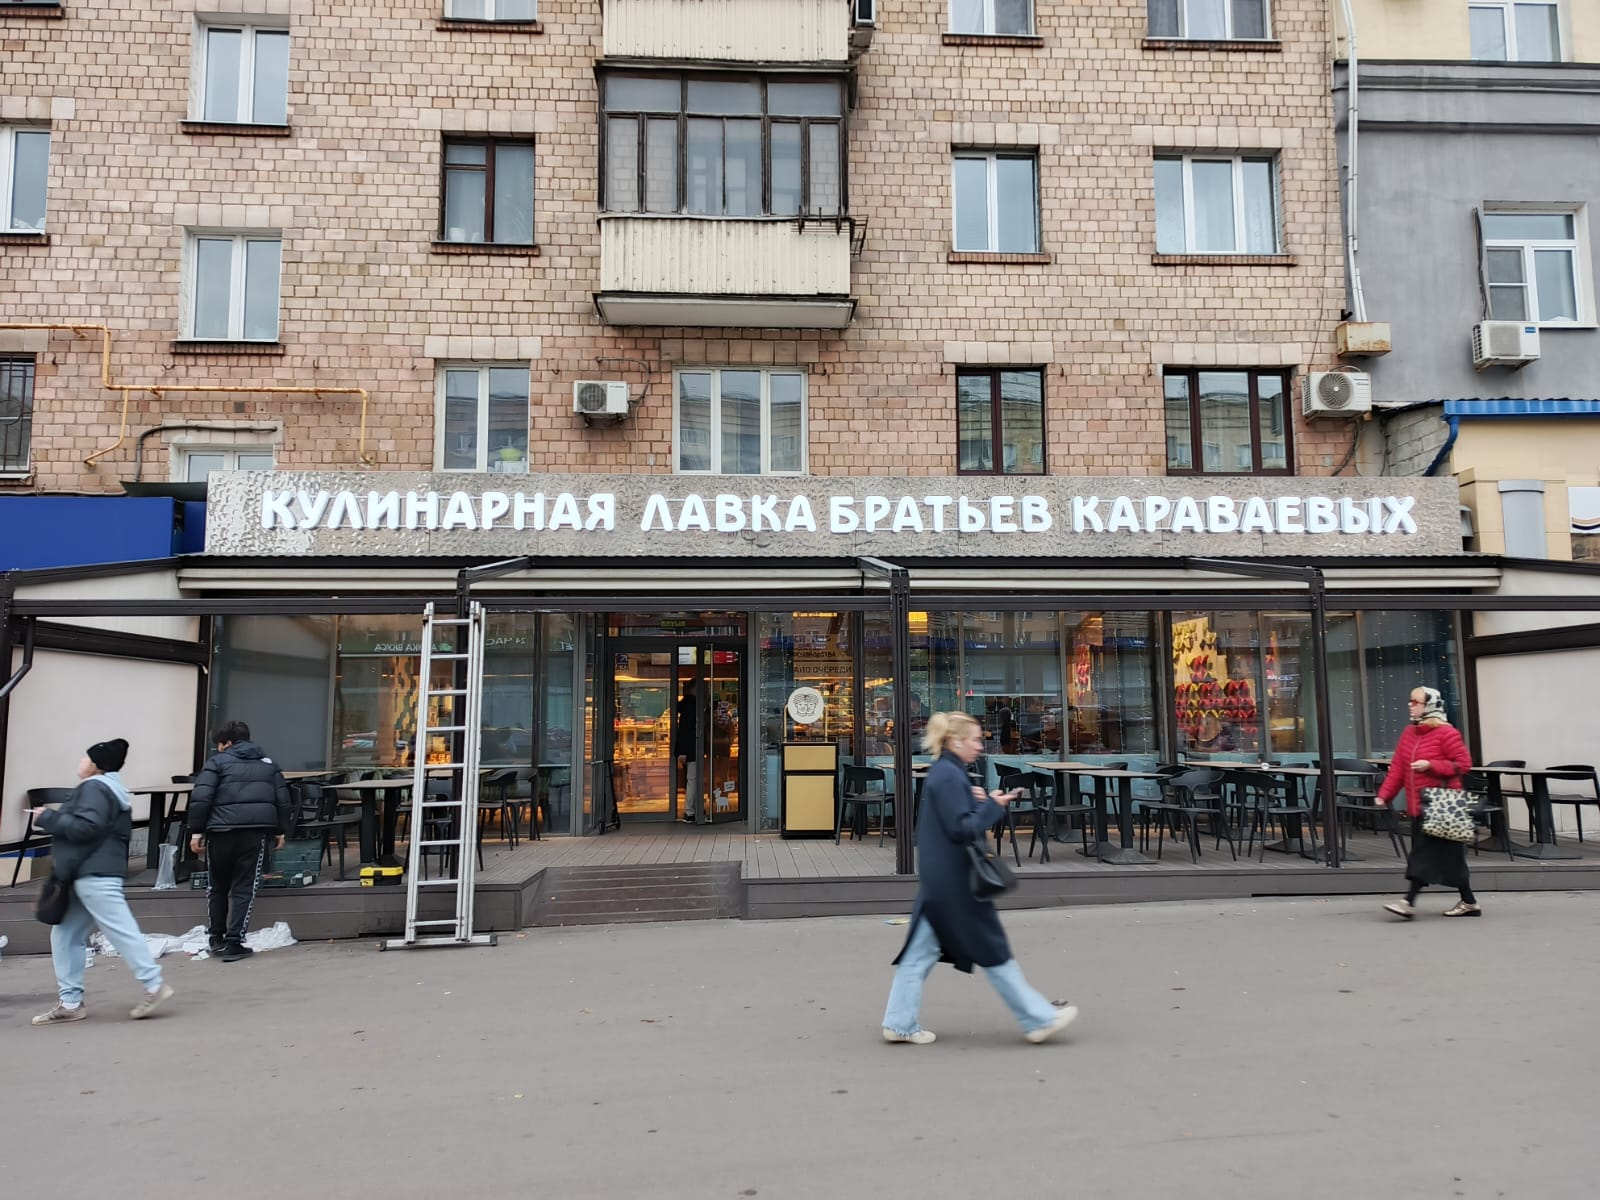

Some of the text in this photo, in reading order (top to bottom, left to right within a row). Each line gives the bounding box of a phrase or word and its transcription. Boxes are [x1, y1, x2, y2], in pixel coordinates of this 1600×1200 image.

[260, 489, 1418, 534] КУЛИНАРНАЯ ЛАВКА БРАТЬЕВ КАРАВАЕВЫХ
